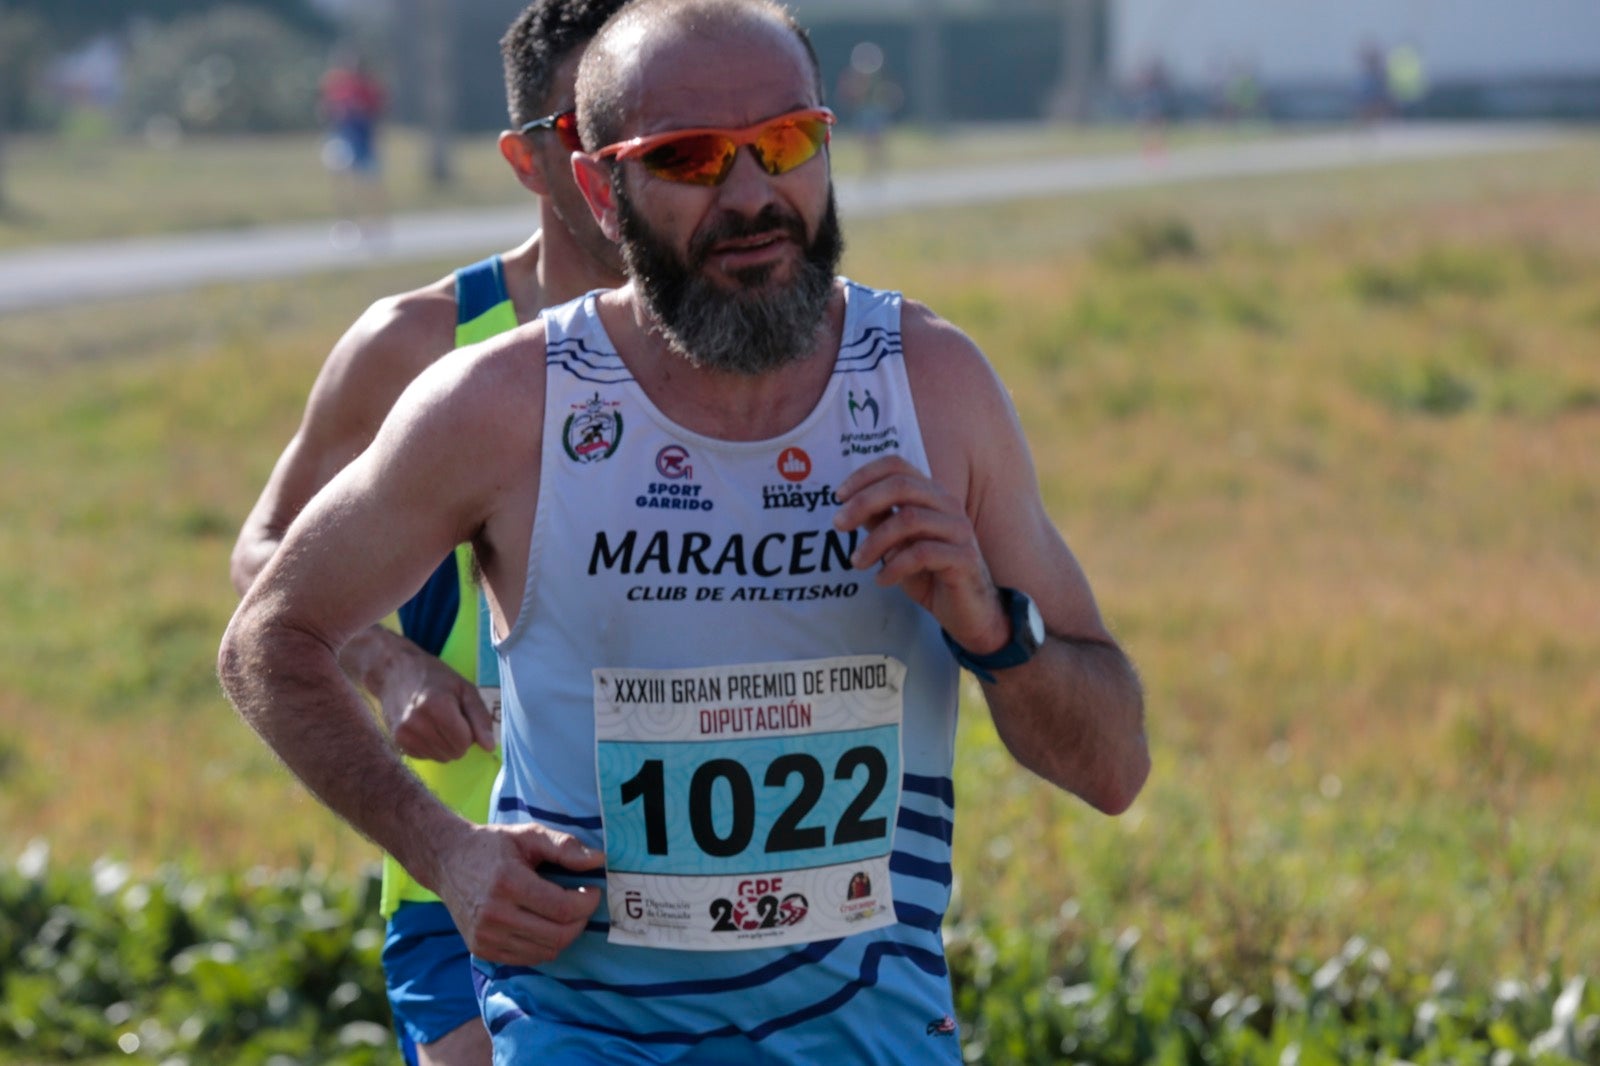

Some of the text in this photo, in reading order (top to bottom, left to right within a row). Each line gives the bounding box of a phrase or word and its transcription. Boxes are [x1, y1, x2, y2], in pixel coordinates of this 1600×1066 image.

[635, 495, 714, 512] GARRIDO
[648, 482, 702, 497] SPORT
[587, 529, 859, 577] MARACEN
[626, 582, 860, 602] CLUB DE ATLETISMO
[614, 663, 888, 704] XXXIII GRAN PREMIO DE FONDO
[699, 700, 813, 735] DIPUTACIÓN
[620, 745, 889, 858] 1022
